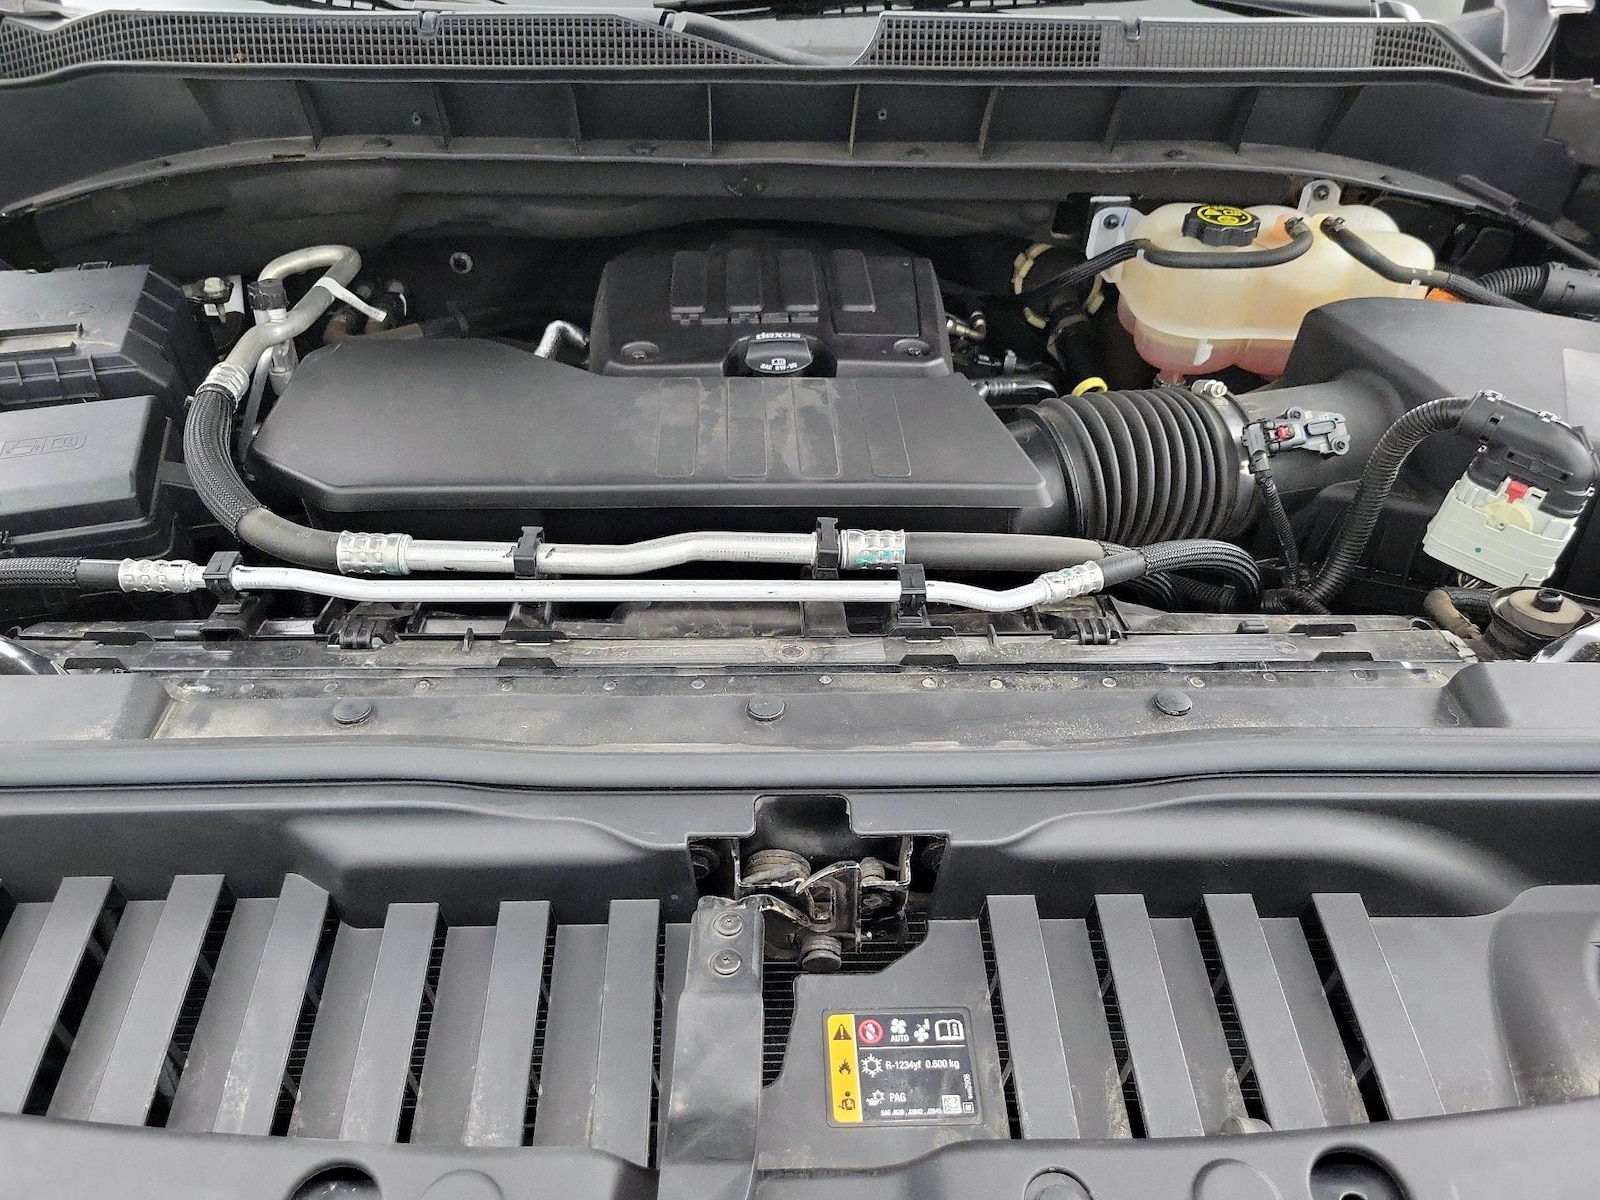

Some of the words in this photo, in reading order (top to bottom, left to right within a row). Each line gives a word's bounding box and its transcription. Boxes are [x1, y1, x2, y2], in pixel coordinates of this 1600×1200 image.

[890, 1034, 909, 1042] AUTO
[885, 1060, 922, 1070] R-1234yf
[925, 1059, 948, 1068] 0.600
[949, 1059, 960, 1069] kg
[889, 1092, 907, 1102] PAG
